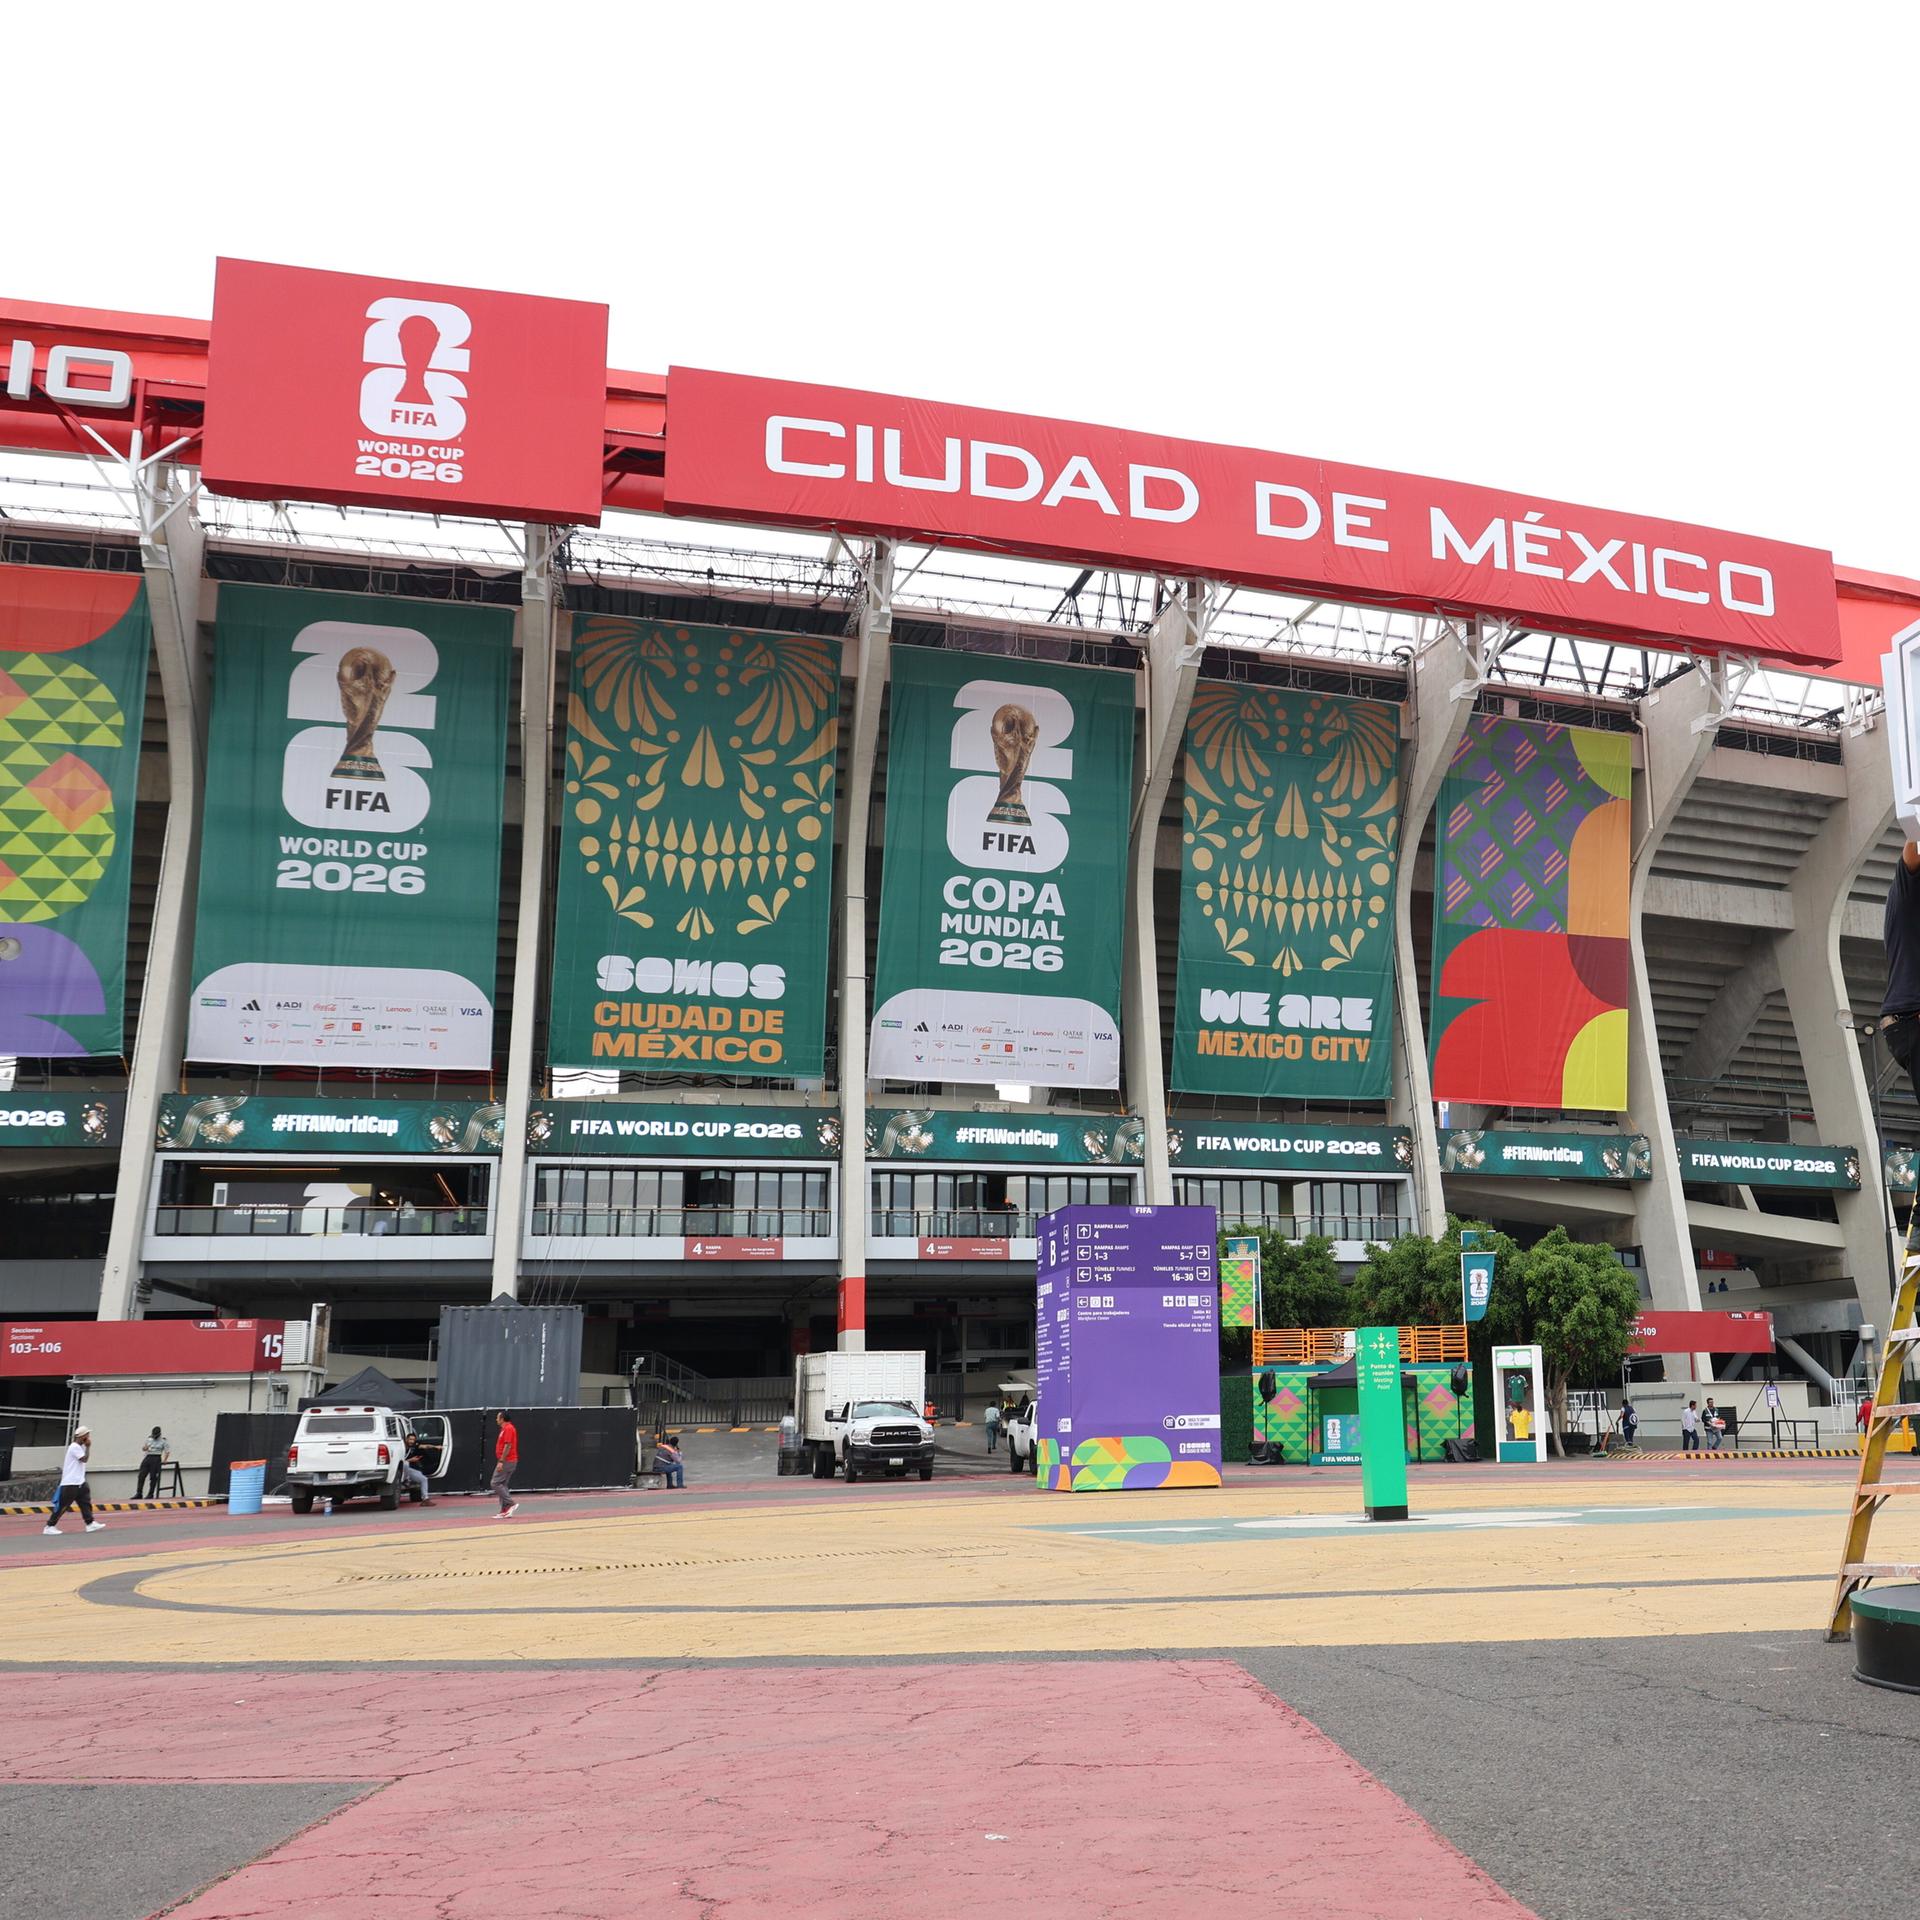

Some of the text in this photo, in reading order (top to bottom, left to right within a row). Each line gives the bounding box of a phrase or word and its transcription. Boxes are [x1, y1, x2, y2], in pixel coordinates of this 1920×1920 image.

[390, 408, 438, 428] FIFA
[357, 439, 465, 460] WORLD CUP
[355, 455, 463, 483] 2026
[765, 415, 1775, 617] CIUDAD DE MÉXICO
[325, 788, 391, 813] FIFA
[279, 836, 428, 861] WORLD CUP
[982, 831, 1037, 855] FIFA
[276, 860, 426, 895] 2026
[942, 875, 1066, 916] COPA
[940, 912, 1065, 941] MUNDIAL
[939, 938, 1064, 972] 2026
[596, 955, 786, 1000] SOMOS
[283, 1001, 302, 1009] ADI
[460, 1007, 483, 1016] VISA
[1200, 988, 1374, 1032] WE ARE
[593, 1001, 785, 1034] CIUDAD DE
[947, 1023, 964, 1031] ADI
[592, 1029, 783, 1064] MÉXICO
[1093, 1032, 1113, 1041] VISA
[1197, 1030, 1370, 1062] MEXICO CITY
[0, 1110, 66, 1127] 2026
[271, 1114, 399, 1137] #FIFAWorldCup
[570, 1119, 802, 1138] FIFA WORLD CUP 2026
[955, 1127, 1059, 1149] #FIFAWorldCup
[1196, 1135, 1380, 1156] FIFA WORLD CUP 2026
[1502, 1145, 1584, 1165] #FIFAWorldCup
[1691, 1153, 1836, 1174] FIFA WORLD CUP 2026
[1094, 1231, 1100, 1239] 4
[692, 1243, 702, 1255] 4
[926, 1243, 935, 1255] 4
[1050, 1240, 1056, 1267] B
[261, 1334, 283, 1358] 15
